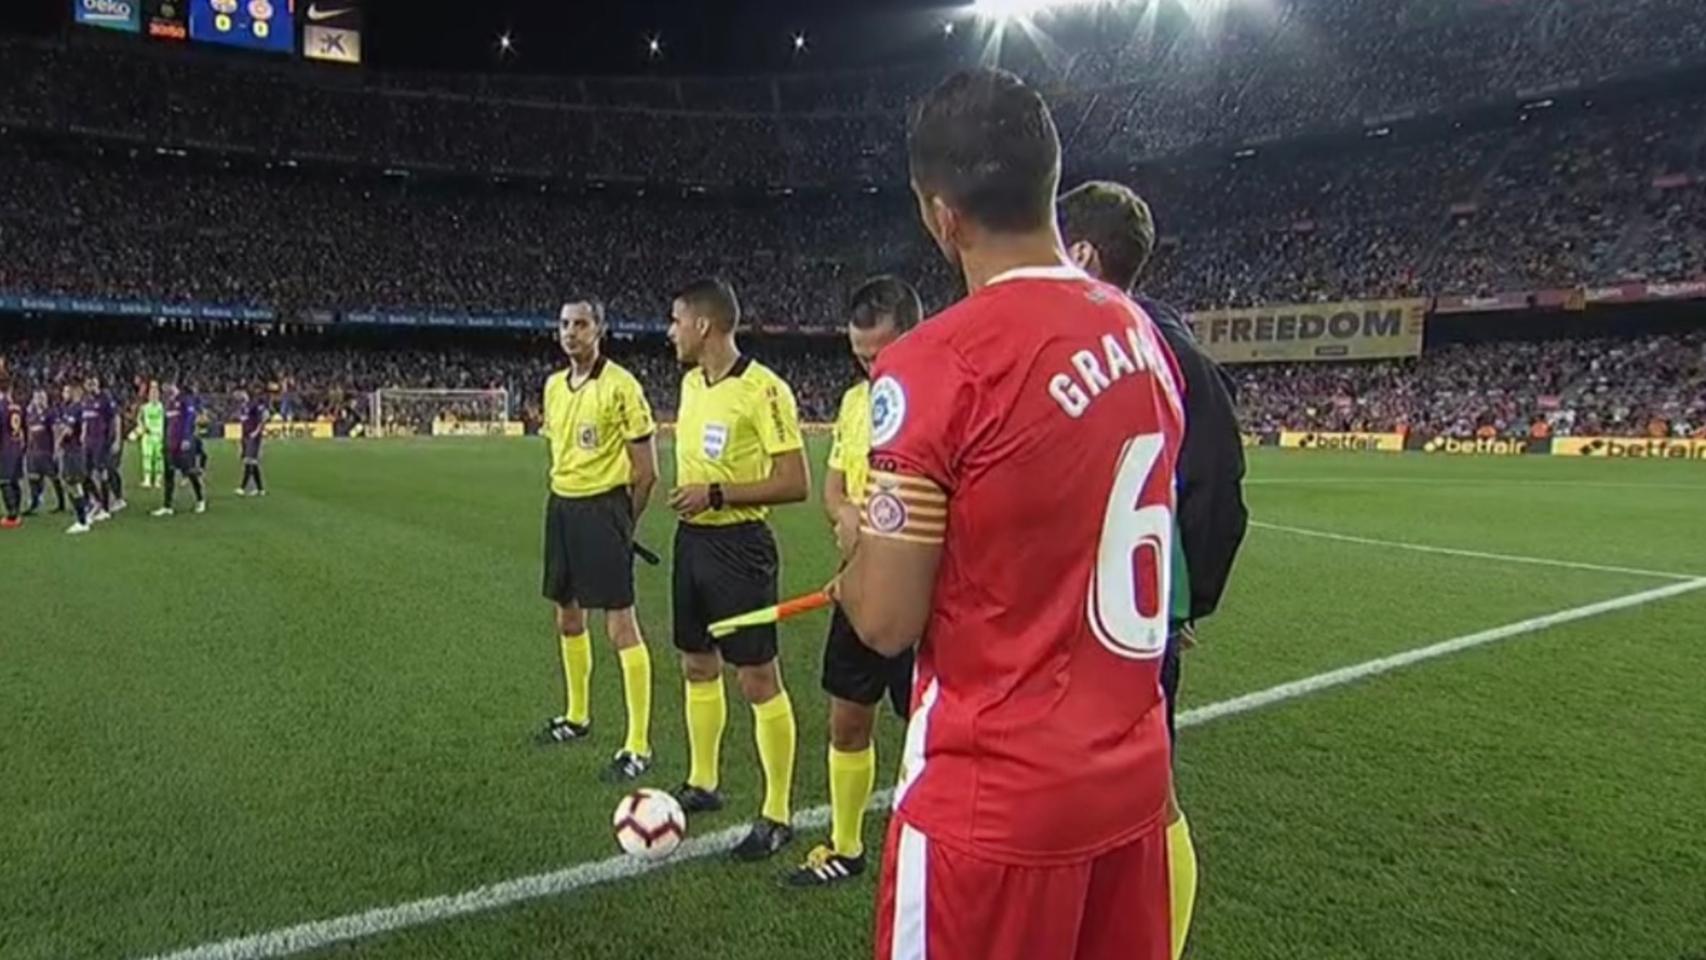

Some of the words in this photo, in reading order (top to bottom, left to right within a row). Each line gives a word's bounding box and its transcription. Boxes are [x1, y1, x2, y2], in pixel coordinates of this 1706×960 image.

[1211, 308, 1402, 344] FREEDOM
[1317, 433, 1382, 449] betfair
[1445, 437, 1527, 455] betfair
[1089, 432, 1171, 659] 6
